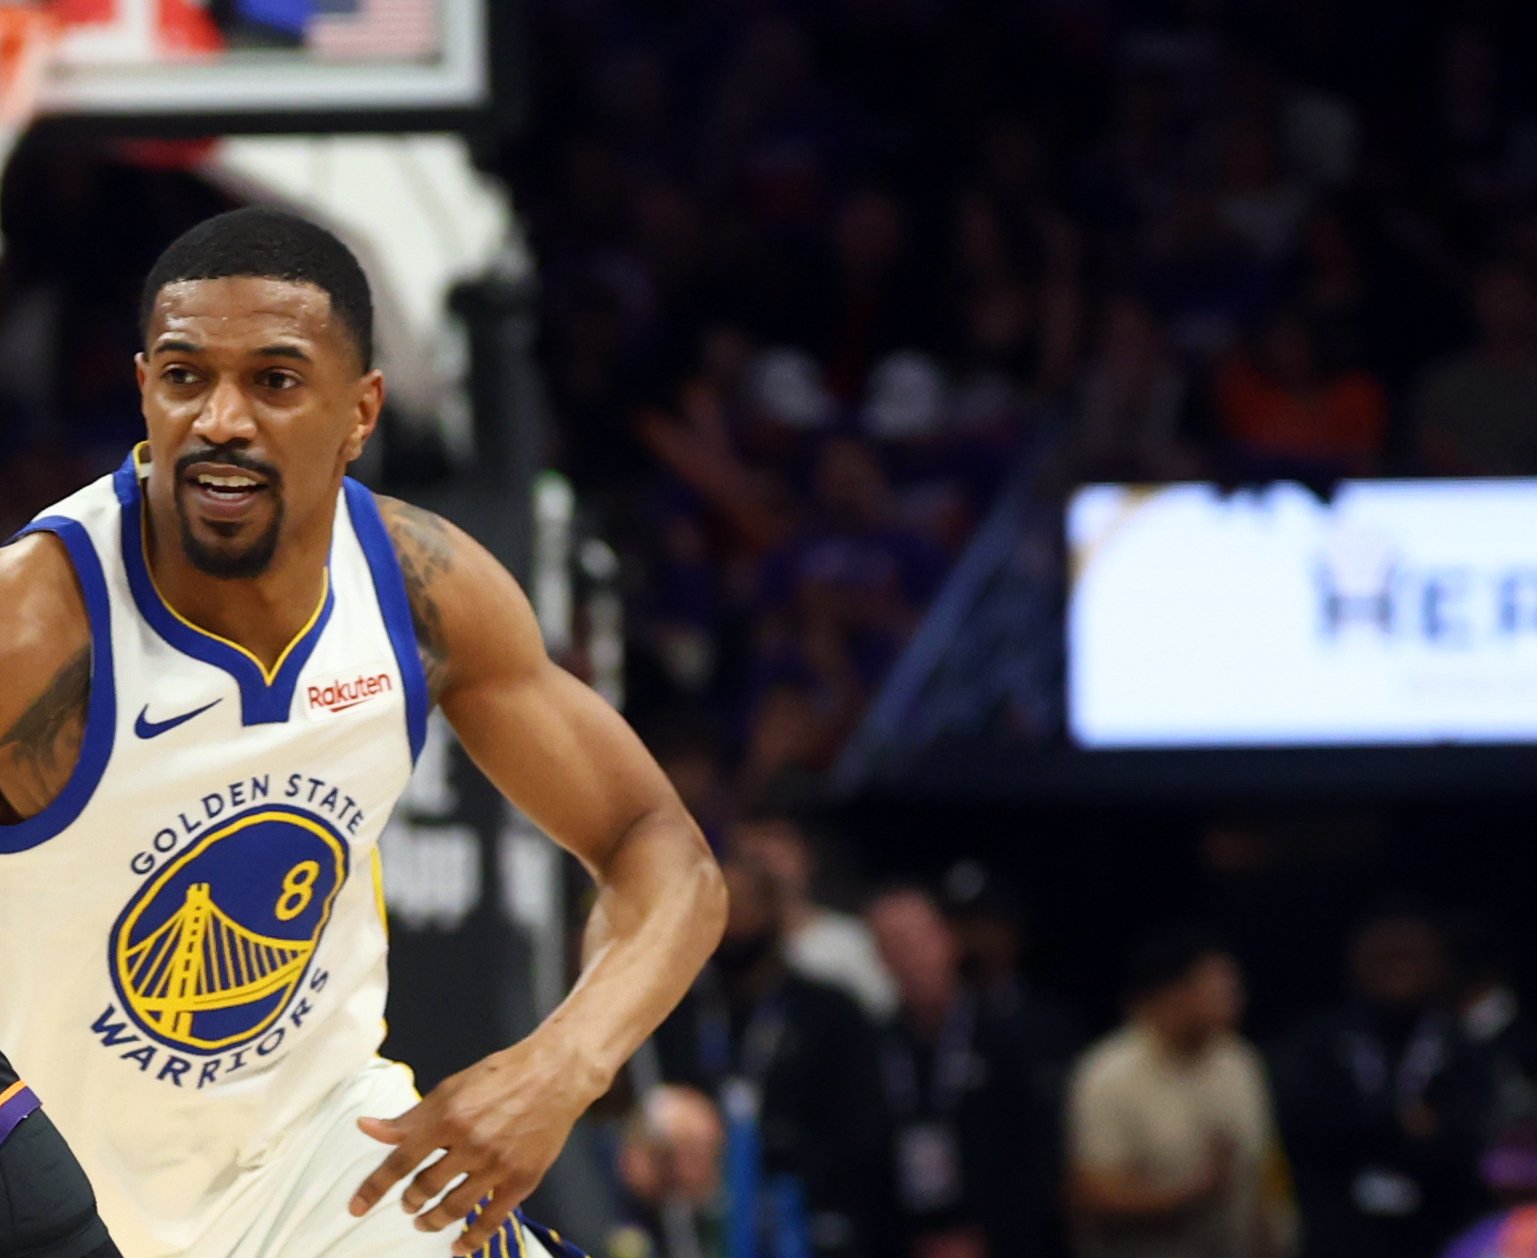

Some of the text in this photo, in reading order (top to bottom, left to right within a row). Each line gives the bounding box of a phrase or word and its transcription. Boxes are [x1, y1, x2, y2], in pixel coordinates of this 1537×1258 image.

[308, 673, 392, 710] Rakuten
[130, 773, 367, 876] GOLDEN STATE
[274, 860, 321, 921] 8
[90, 967, 331, 1089] WARRIORS
